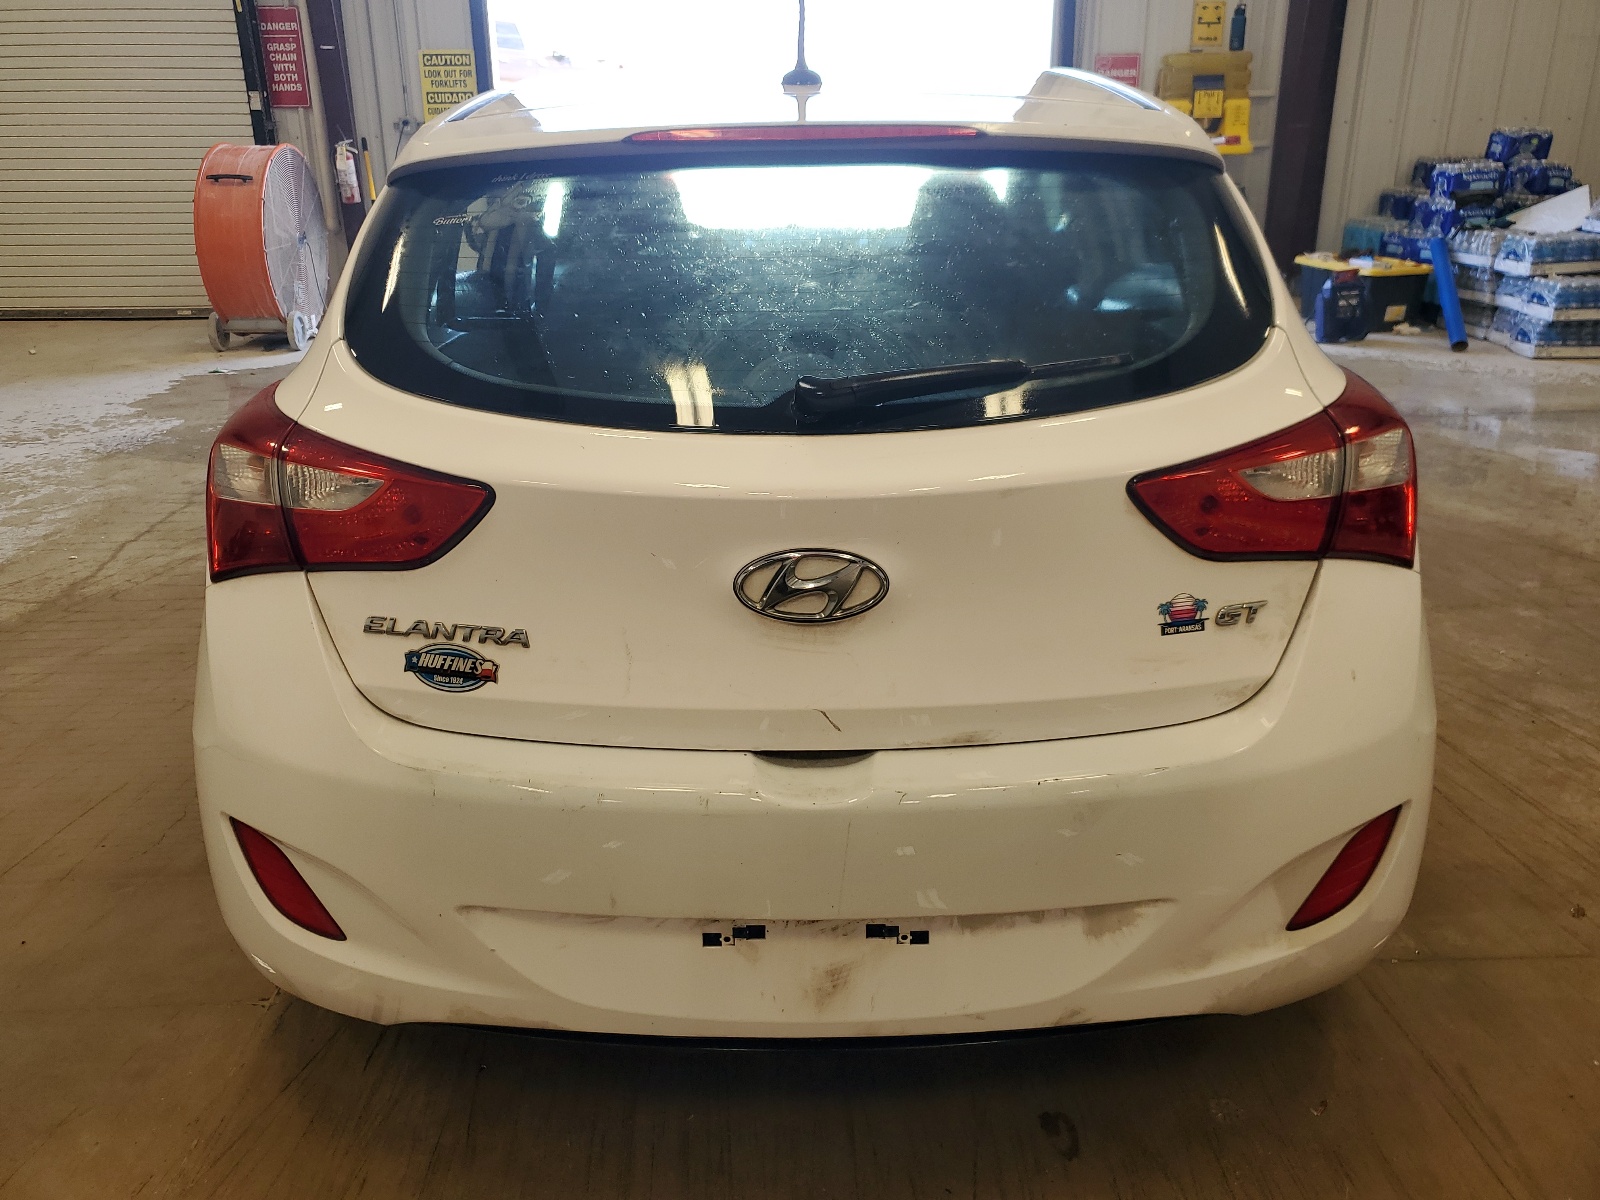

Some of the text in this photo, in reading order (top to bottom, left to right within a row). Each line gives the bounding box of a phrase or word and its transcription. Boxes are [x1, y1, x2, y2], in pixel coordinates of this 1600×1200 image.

[261, 22, 298, 31] DANGER
[266, 42, 297, 52] GRASP
[269, 53, 297, 62] CHAIN
[423, 55, 470, 66] CAUTION
[273, 63, 296, 72] WITH
[273, 73, 299, 82] BOTH
[423, 69, 473, 79] LOOK OUT FOR
[272, 83, 303, 92] HANDS
[431, 79, 468, 89] FORKLIFTS
[1214, 599, 1269, 627] GT
[362, 615, 531, 649] ELANTRA
[1164, 623, 1202, 635] PORT ARANSAS
[417, 652, 484, 675] HUFFINES
[433, 674, 450, 684] Since
